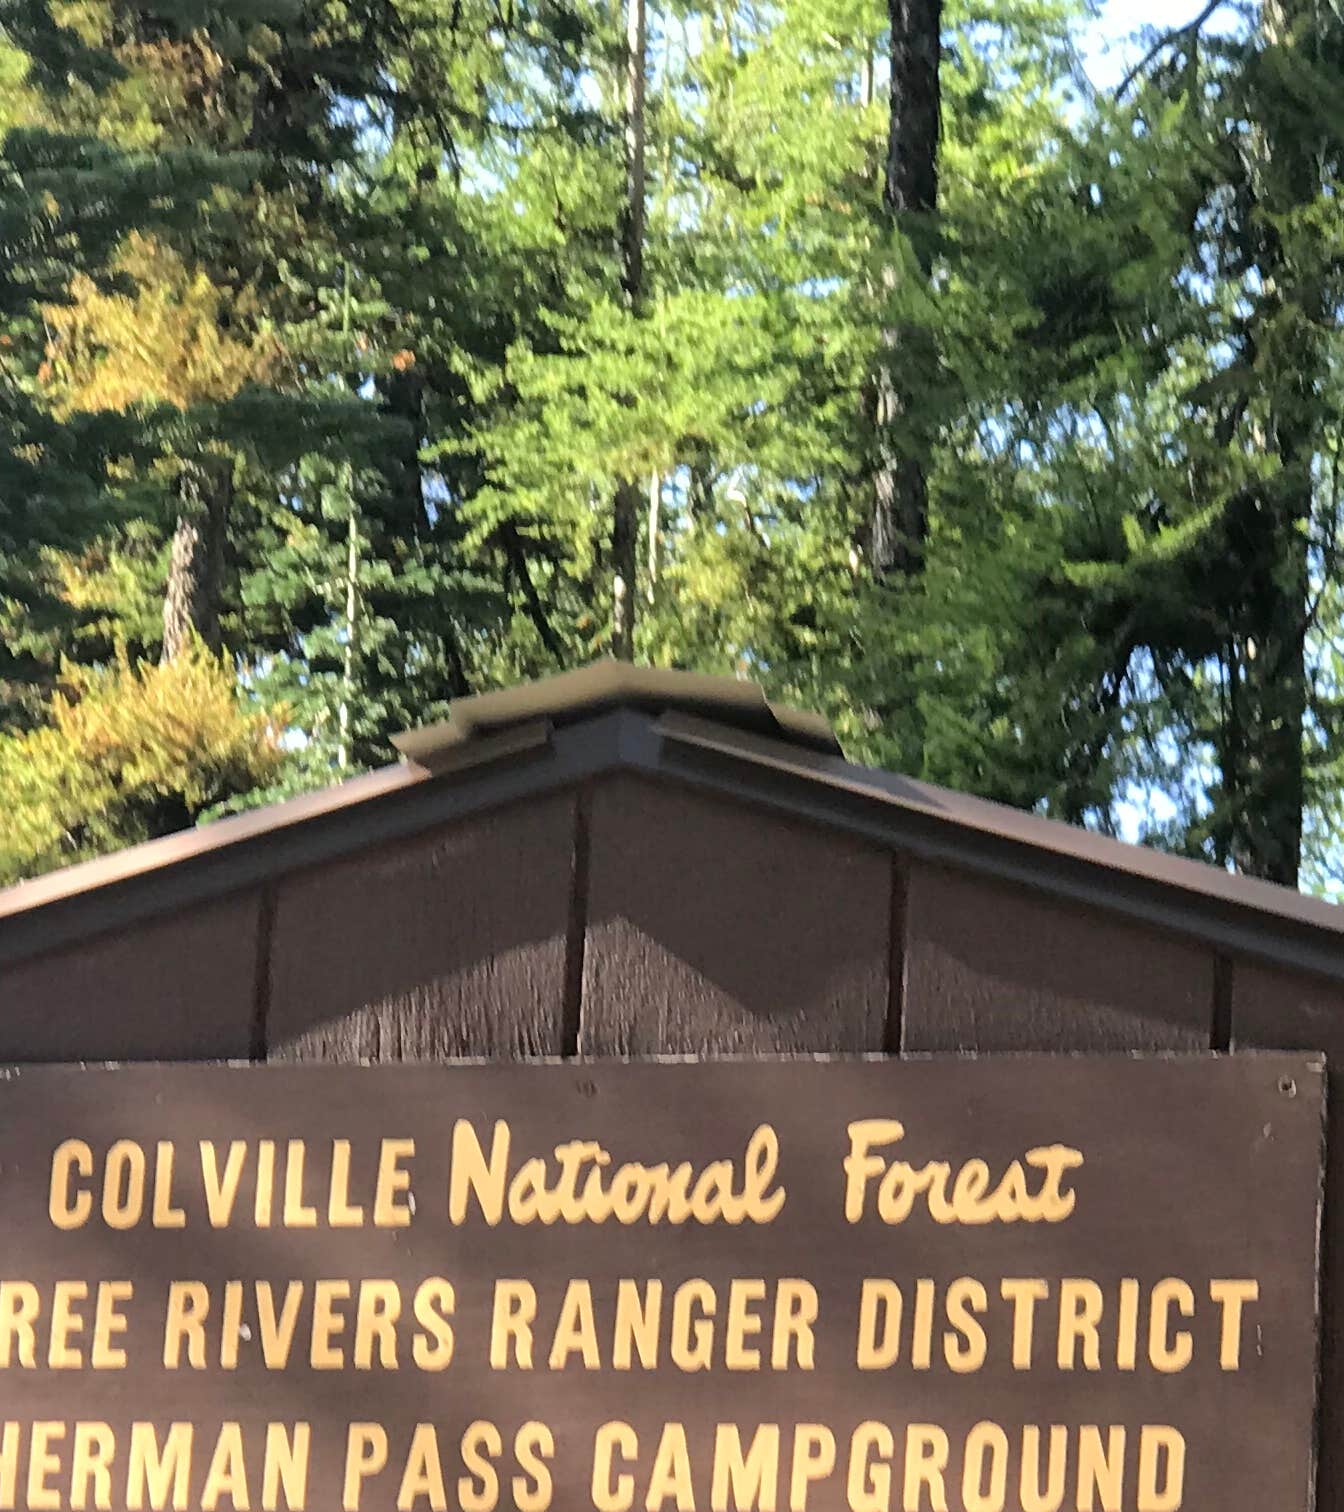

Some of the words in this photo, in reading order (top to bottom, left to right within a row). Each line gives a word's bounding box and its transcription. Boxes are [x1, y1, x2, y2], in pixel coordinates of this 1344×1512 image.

[49, 1138, 415, 1229] COLVILLE
[449, 1119, 786, 1225] National
[843, 1119, 1083, 1226] Forest
[163, 1278, 456, 1372] RIVERS
[488, 1278, 819, 1372] RANGER
[855, 1276, 1261, 1374] DISTRICT
